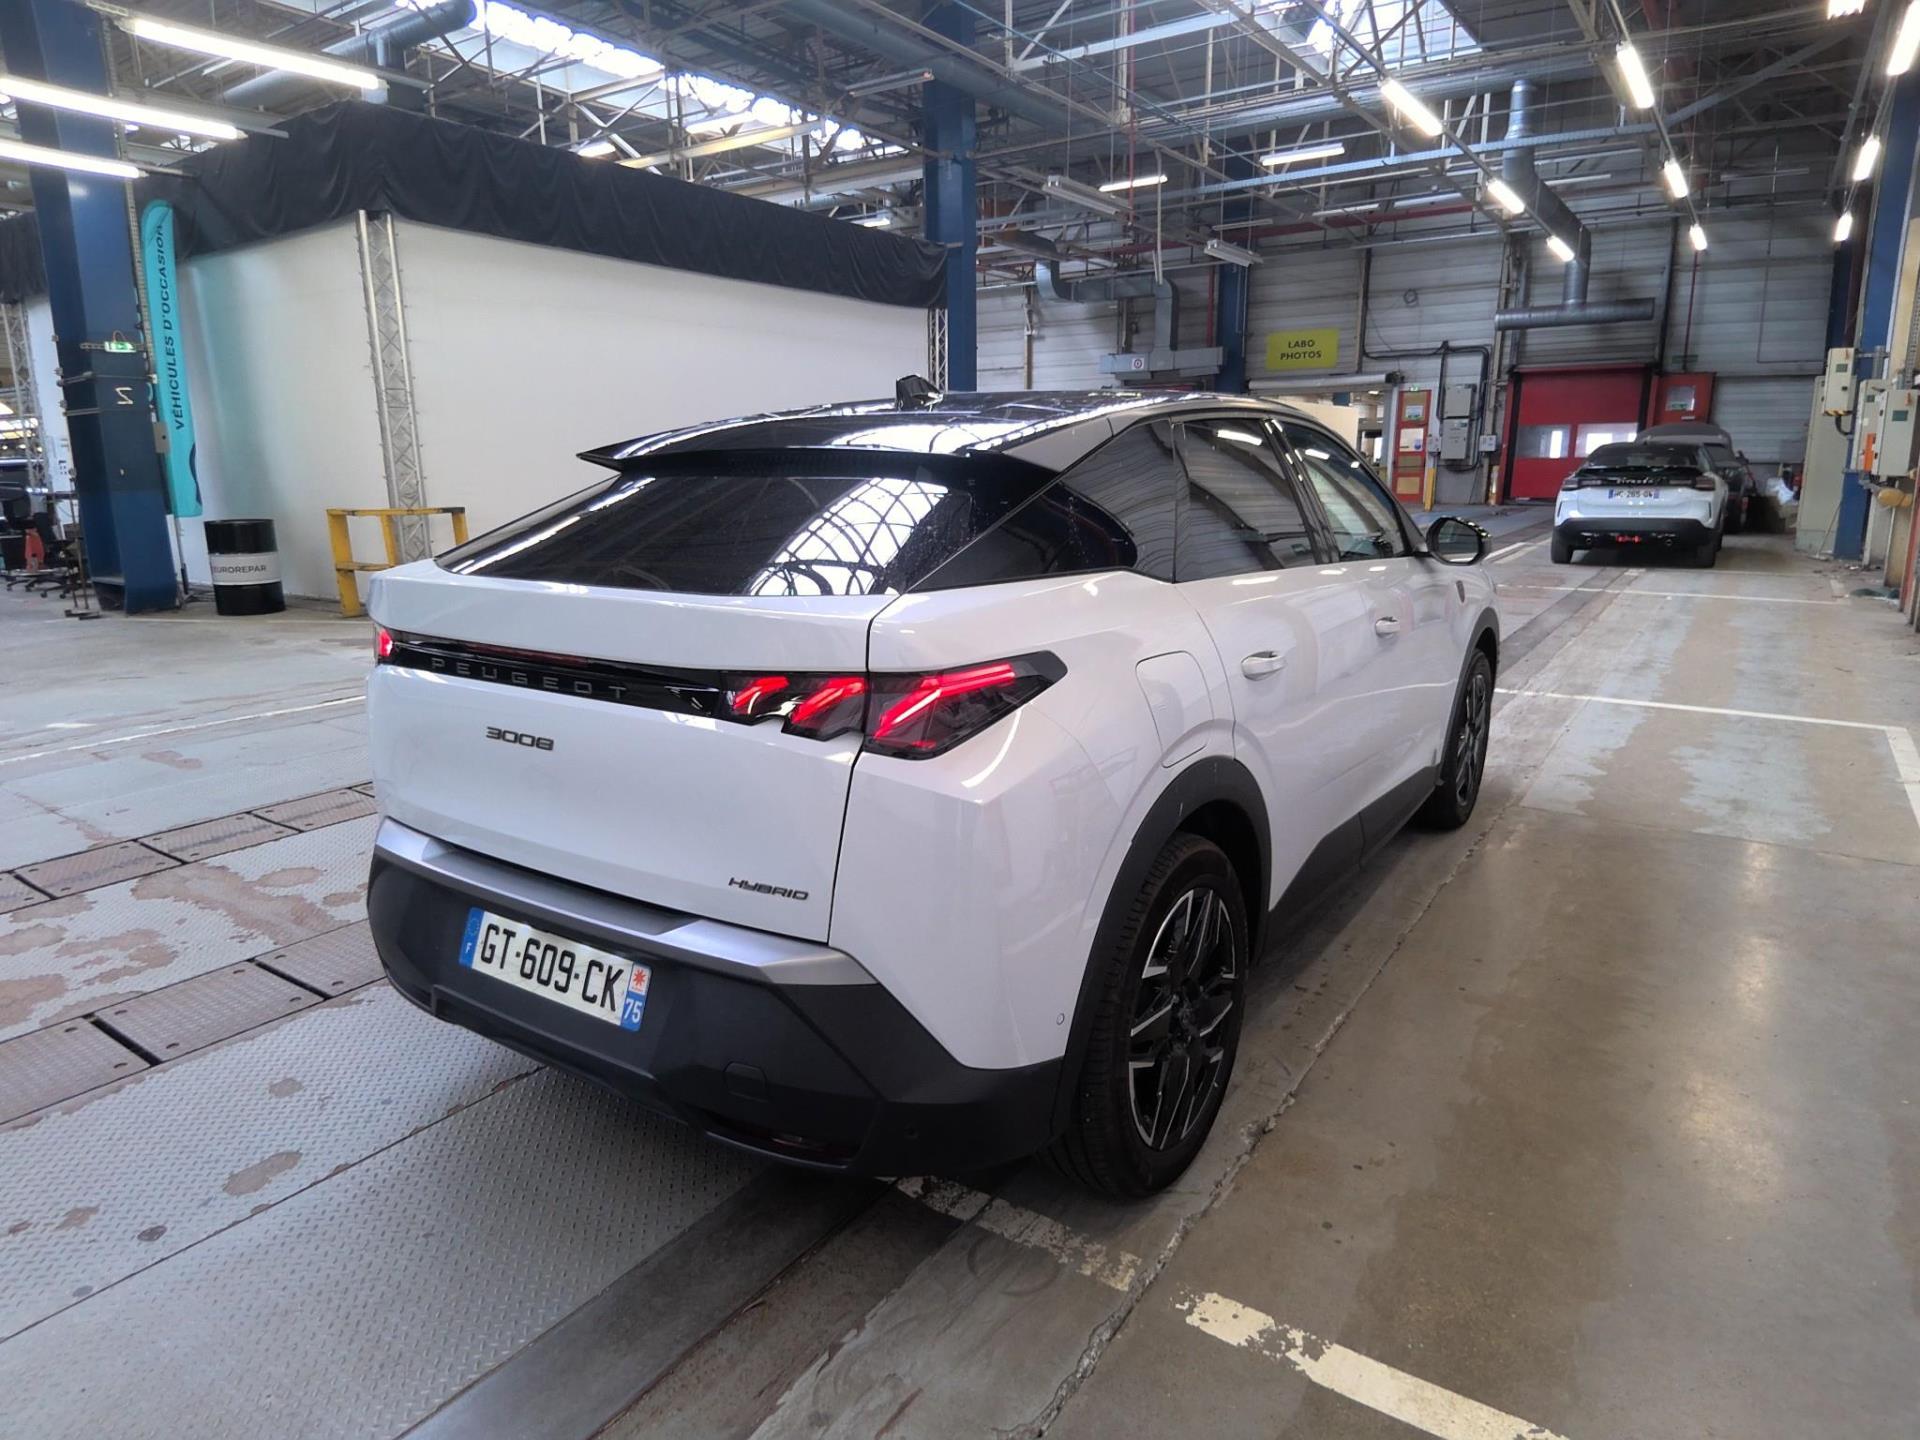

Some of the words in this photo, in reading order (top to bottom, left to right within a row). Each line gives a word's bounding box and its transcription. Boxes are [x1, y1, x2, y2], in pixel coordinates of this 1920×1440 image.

[1280, 350, 1322, 360] PHOTOS
[1288, 340, 1315, 349] LABO
[431, 657, 627, 700] PEUGEOT
[486, 726, 554, 751] 3008
[728, 877, 809, 901] HYBRID
[464, 942, 472, 954] F
[623, 997, 643, 1024] 75
